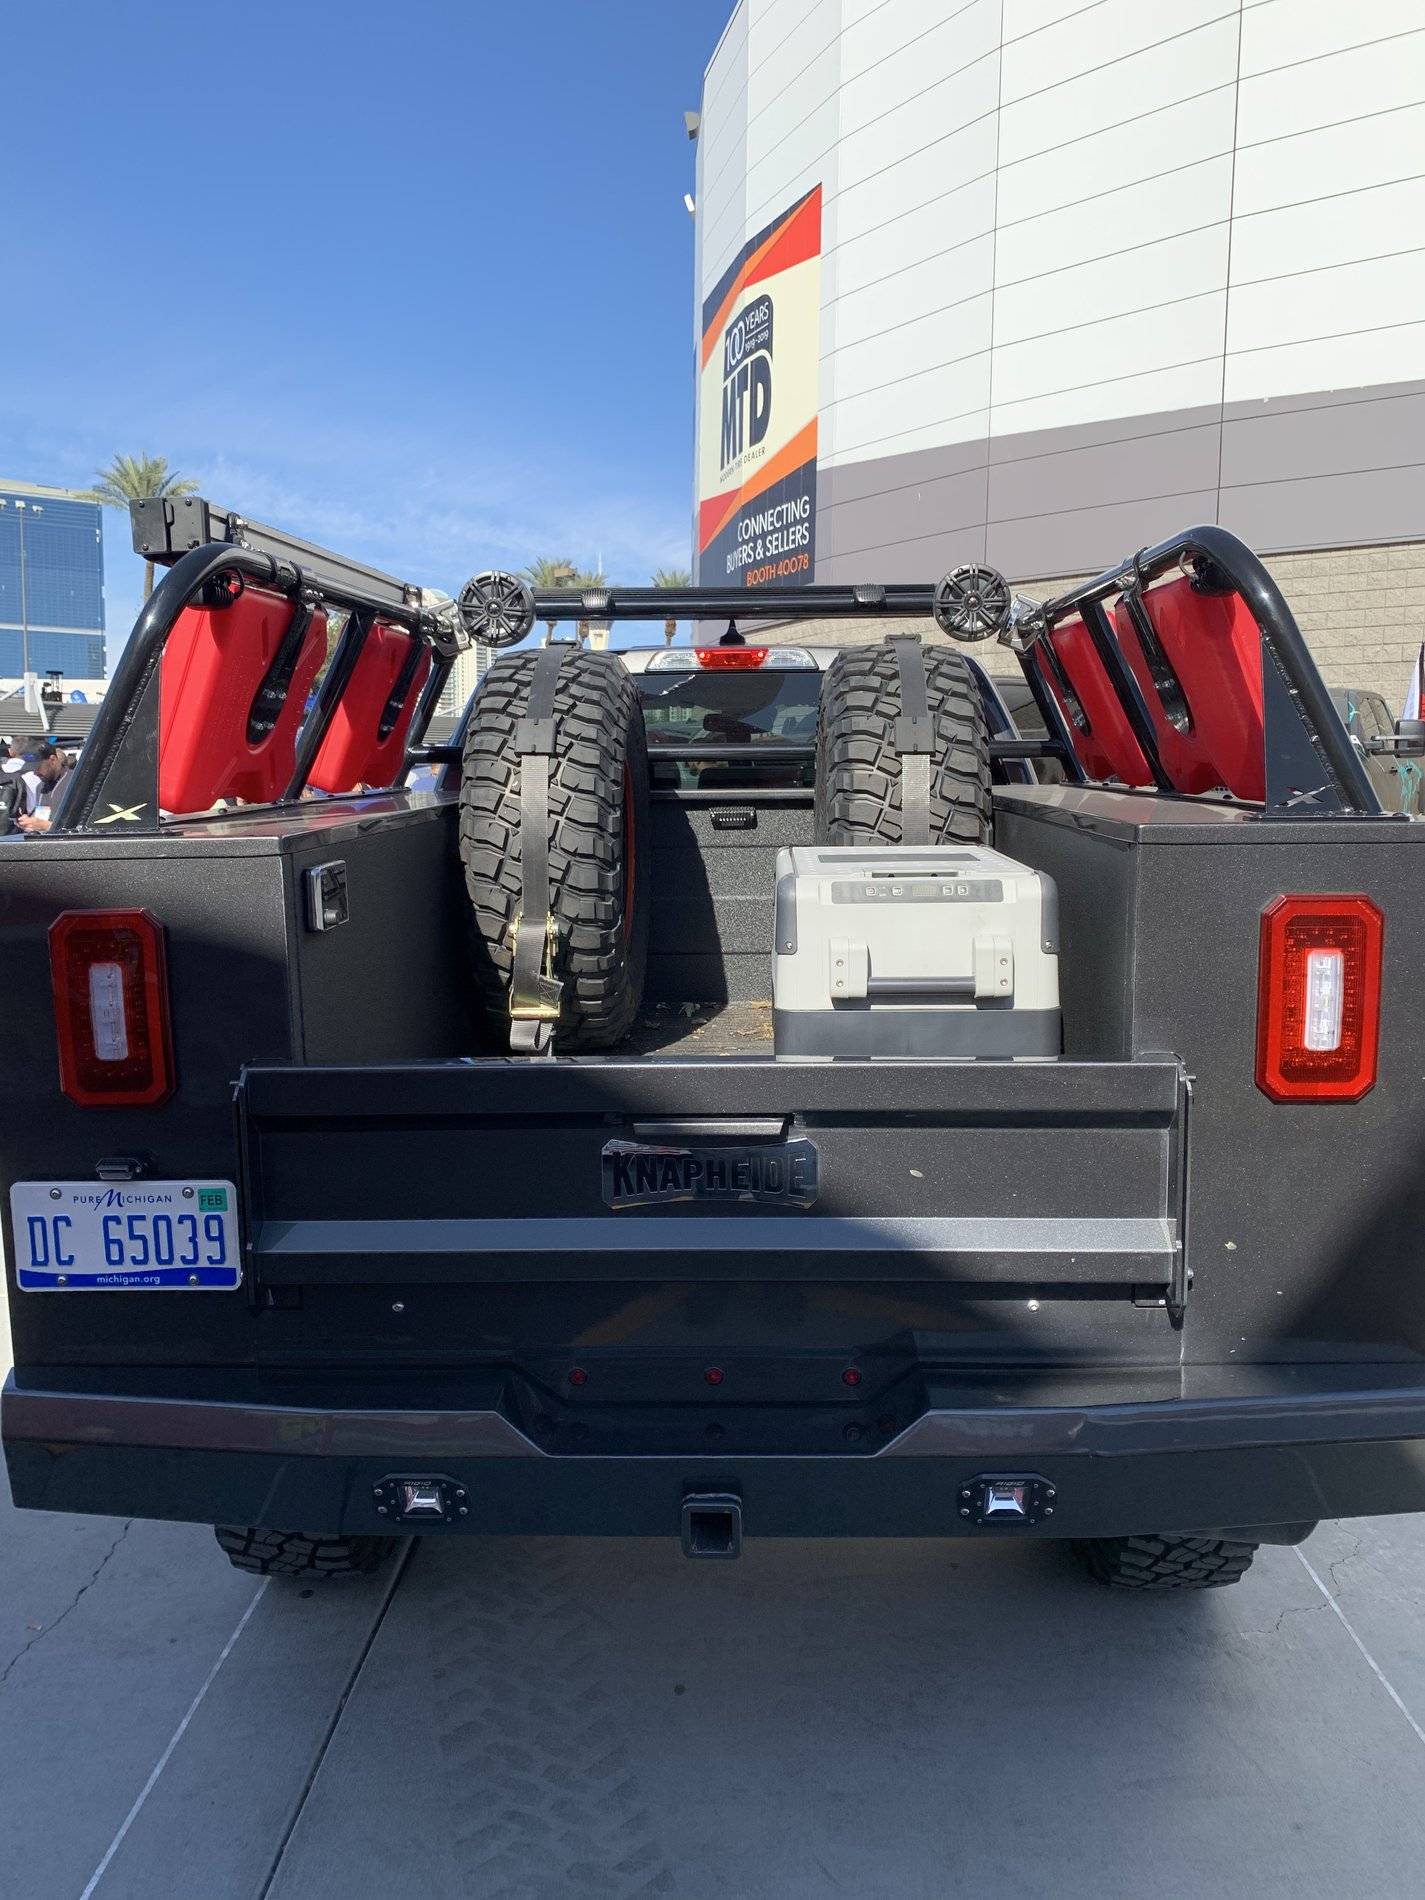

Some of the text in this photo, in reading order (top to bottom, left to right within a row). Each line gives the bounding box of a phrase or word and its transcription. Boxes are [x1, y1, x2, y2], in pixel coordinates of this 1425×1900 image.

[725, 301, 769, 371] 100 YEARS
[720, 355, 772, 471] MTD
[737, 495, 810, 542] CONNECTING
[726, 522, 810, 574] BUYERS & SELLERS
[746, 553, 809, 587] BOOTH 40078
[612, 1152, 808, 1199] KNAPHEIDE
[73, 1195, 100, 1204] PURE
[200, 1194, 223, 1206] FEB
[27, 1214, 227, 1267] DC 65039
[96, 1275, 161, 1286] michigan.org
